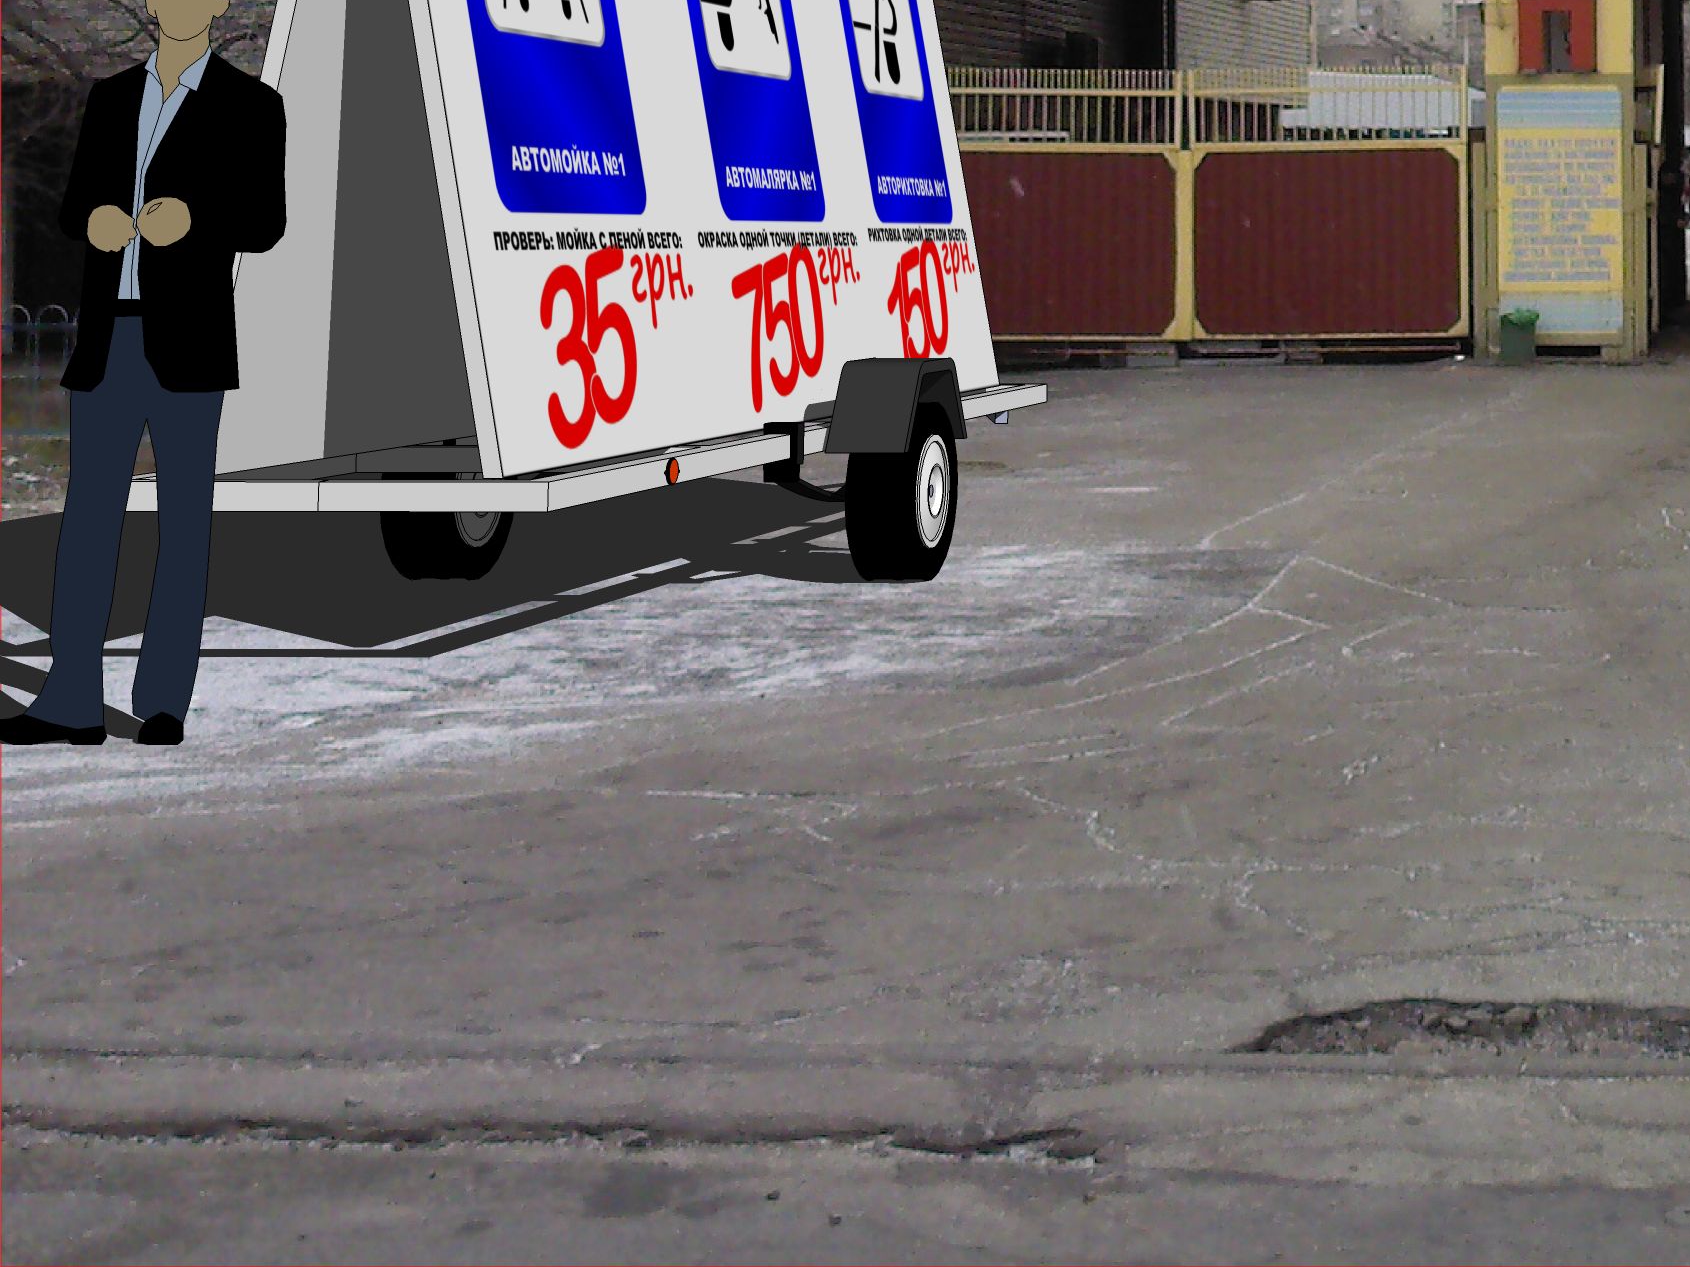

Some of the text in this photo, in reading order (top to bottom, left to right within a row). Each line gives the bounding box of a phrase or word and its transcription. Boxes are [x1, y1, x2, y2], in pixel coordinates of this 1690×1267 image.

[511, 144, 626, 177] АВТОМОЙКА №1
[725, 165, 817, 192] АВТОМАЛЯРКА №1
[877, 175, 947, 198] АВТОРИХТОВКА №1
[493, 228, 683, 251] ПРОВЕРЬ: МОЙКА С ПЕНОЙ ВСЕГО:
[697, 229, 858, 251] ОКРАСКА ОДНОЙ ТОЧКИ (ДЕТАЛИ) ВСЕГО:
[867, 225, 968, 245] РИХТОВКА ОДНОЙ ДЕТАЛИ ВСЕГО:
[887, 239, 976, 359] 150 грн.
[731, 243, 860, 414] 750 грн.
[539, 246, 694, 450] 35 грн.
